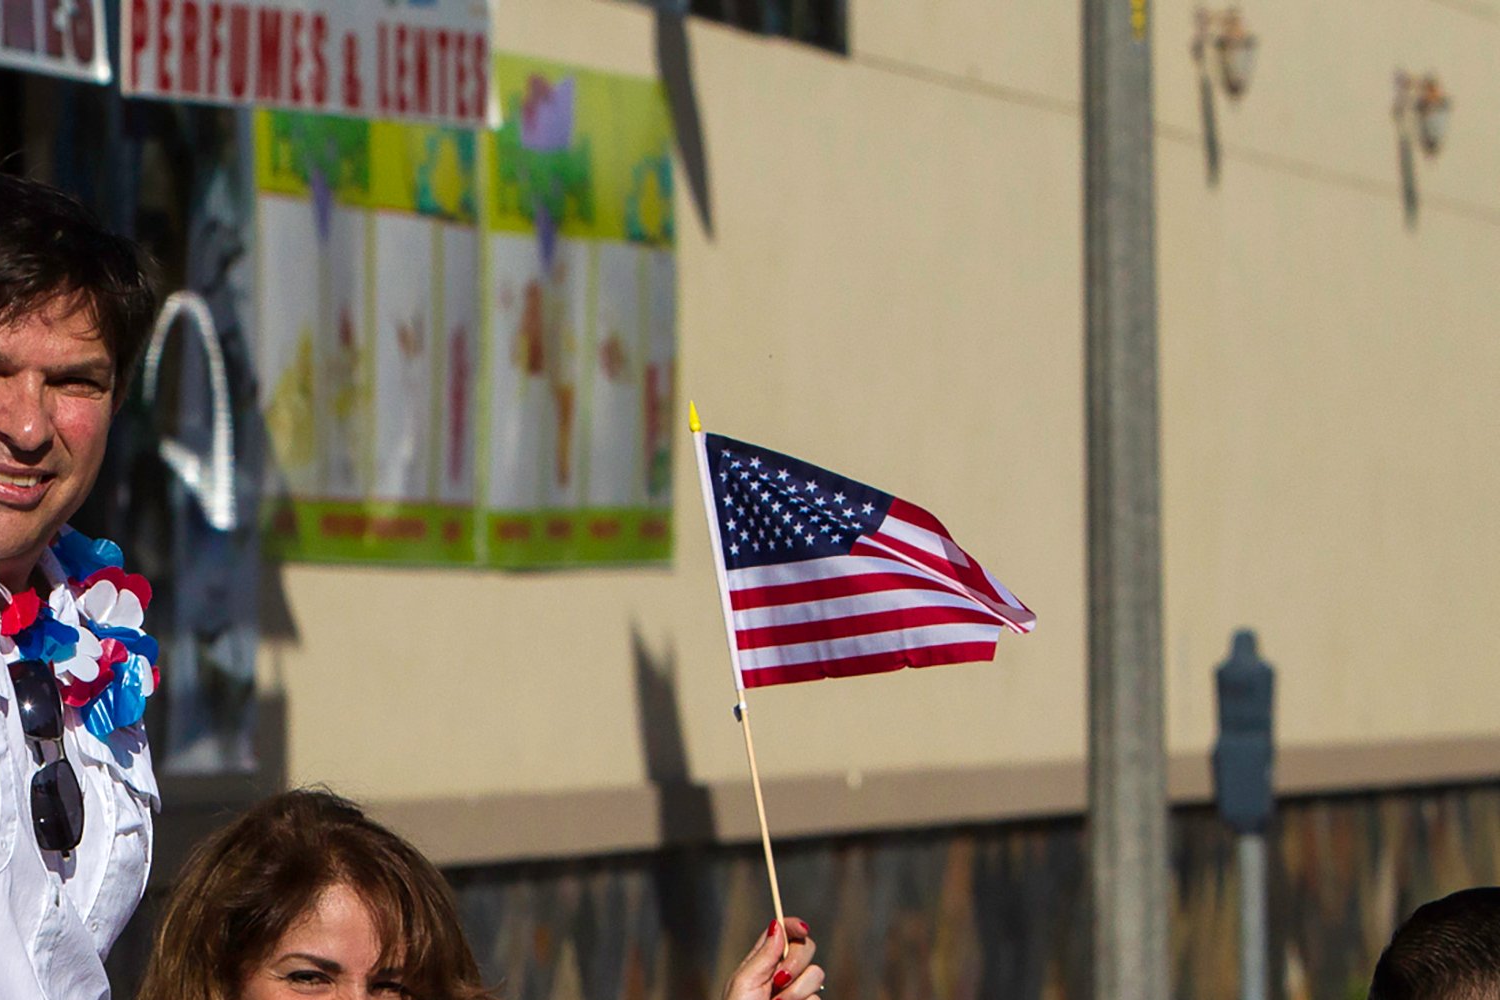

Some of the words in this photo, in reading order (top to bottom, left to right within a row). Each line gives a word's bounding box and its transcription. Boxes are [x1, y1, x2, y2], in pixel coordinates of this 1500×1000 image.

[130, 0, 330, 107] PERFUMES
[342, 30, 362, 109] &
[376, 20, 489, 122] LENTES
